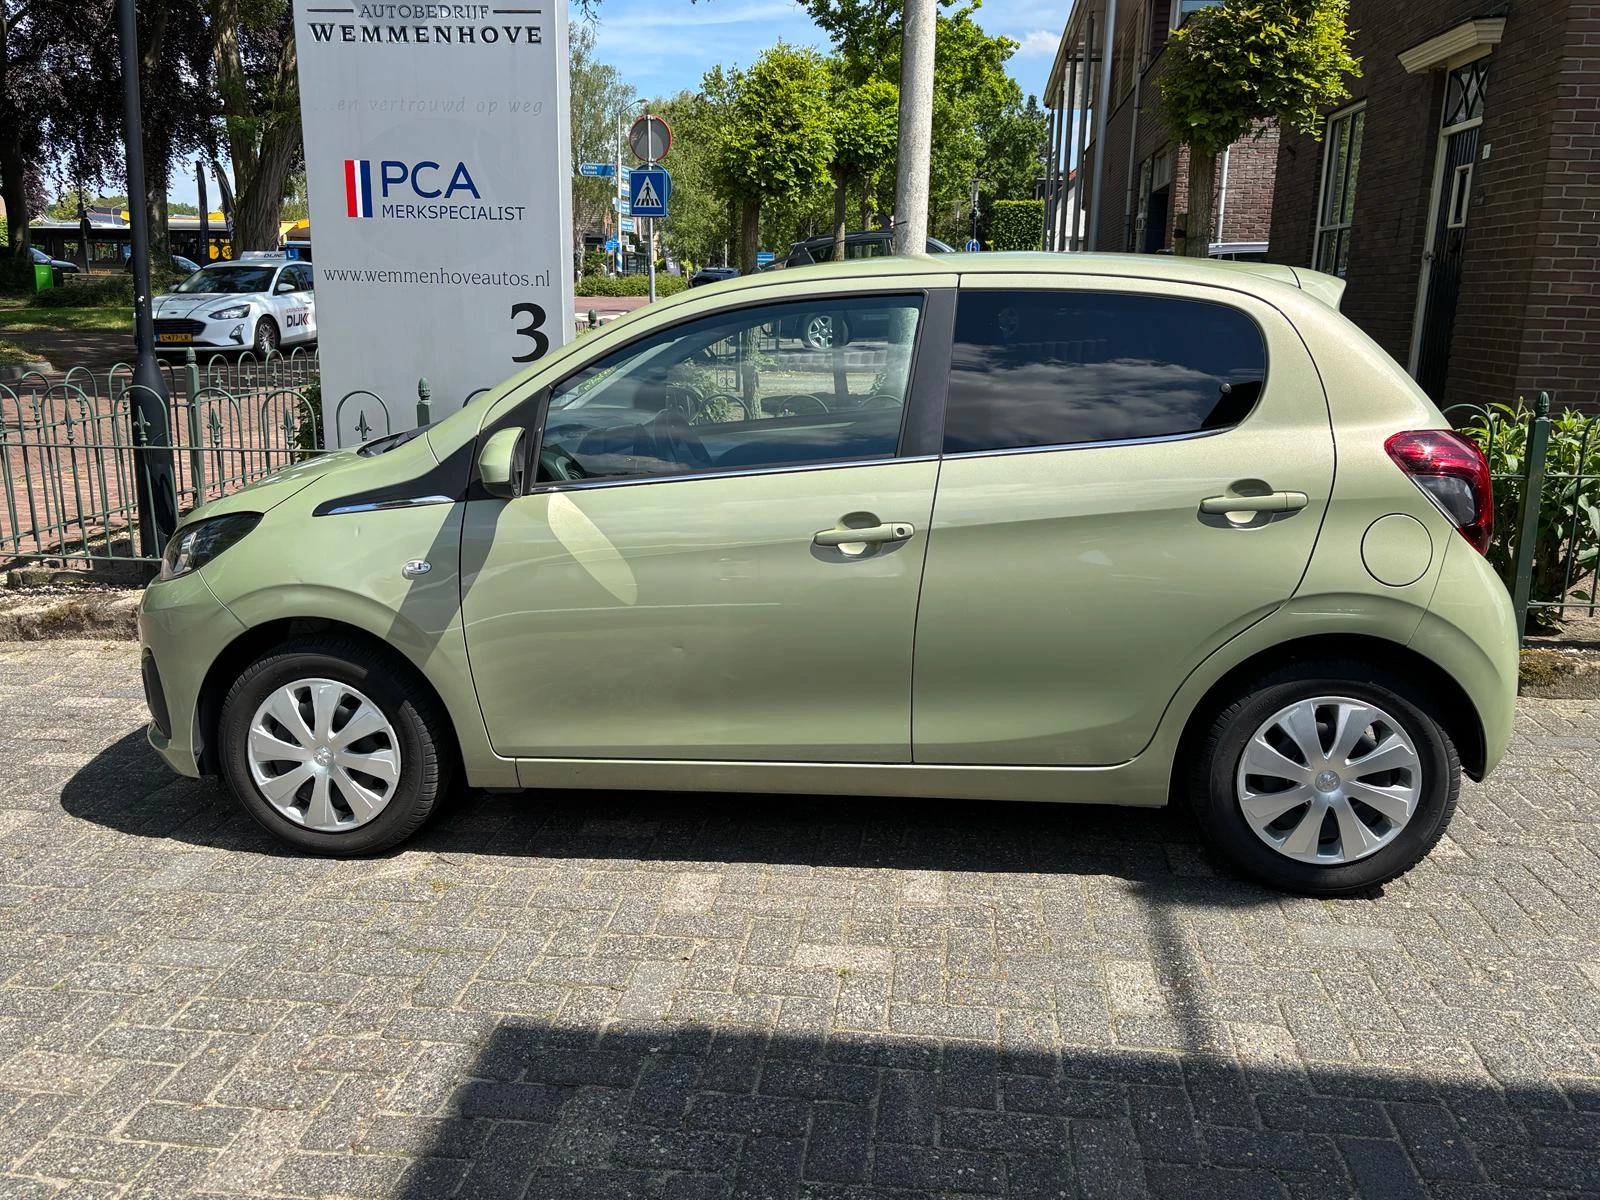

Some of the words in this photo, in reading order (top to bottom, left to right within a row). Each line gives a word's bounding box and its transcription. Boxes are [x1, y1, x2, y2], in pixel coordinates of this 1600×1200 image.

[358, 4, 490, 20] AUTOBEDRIJF
[308, 22, 543, 44] WEMMENHOVE
[369, 97, 466, 113] vertrouwd
[475, 100, 498, 116] op
[507, 100, 544, 115] weg
[381, 160, 481, 199] PCA
[381, 204, 526, 221] MERKSPECIALIST
[323, 266, 551, 287] www.wemmenhoveautos.nl
[510, 302, 550, 363] 3
